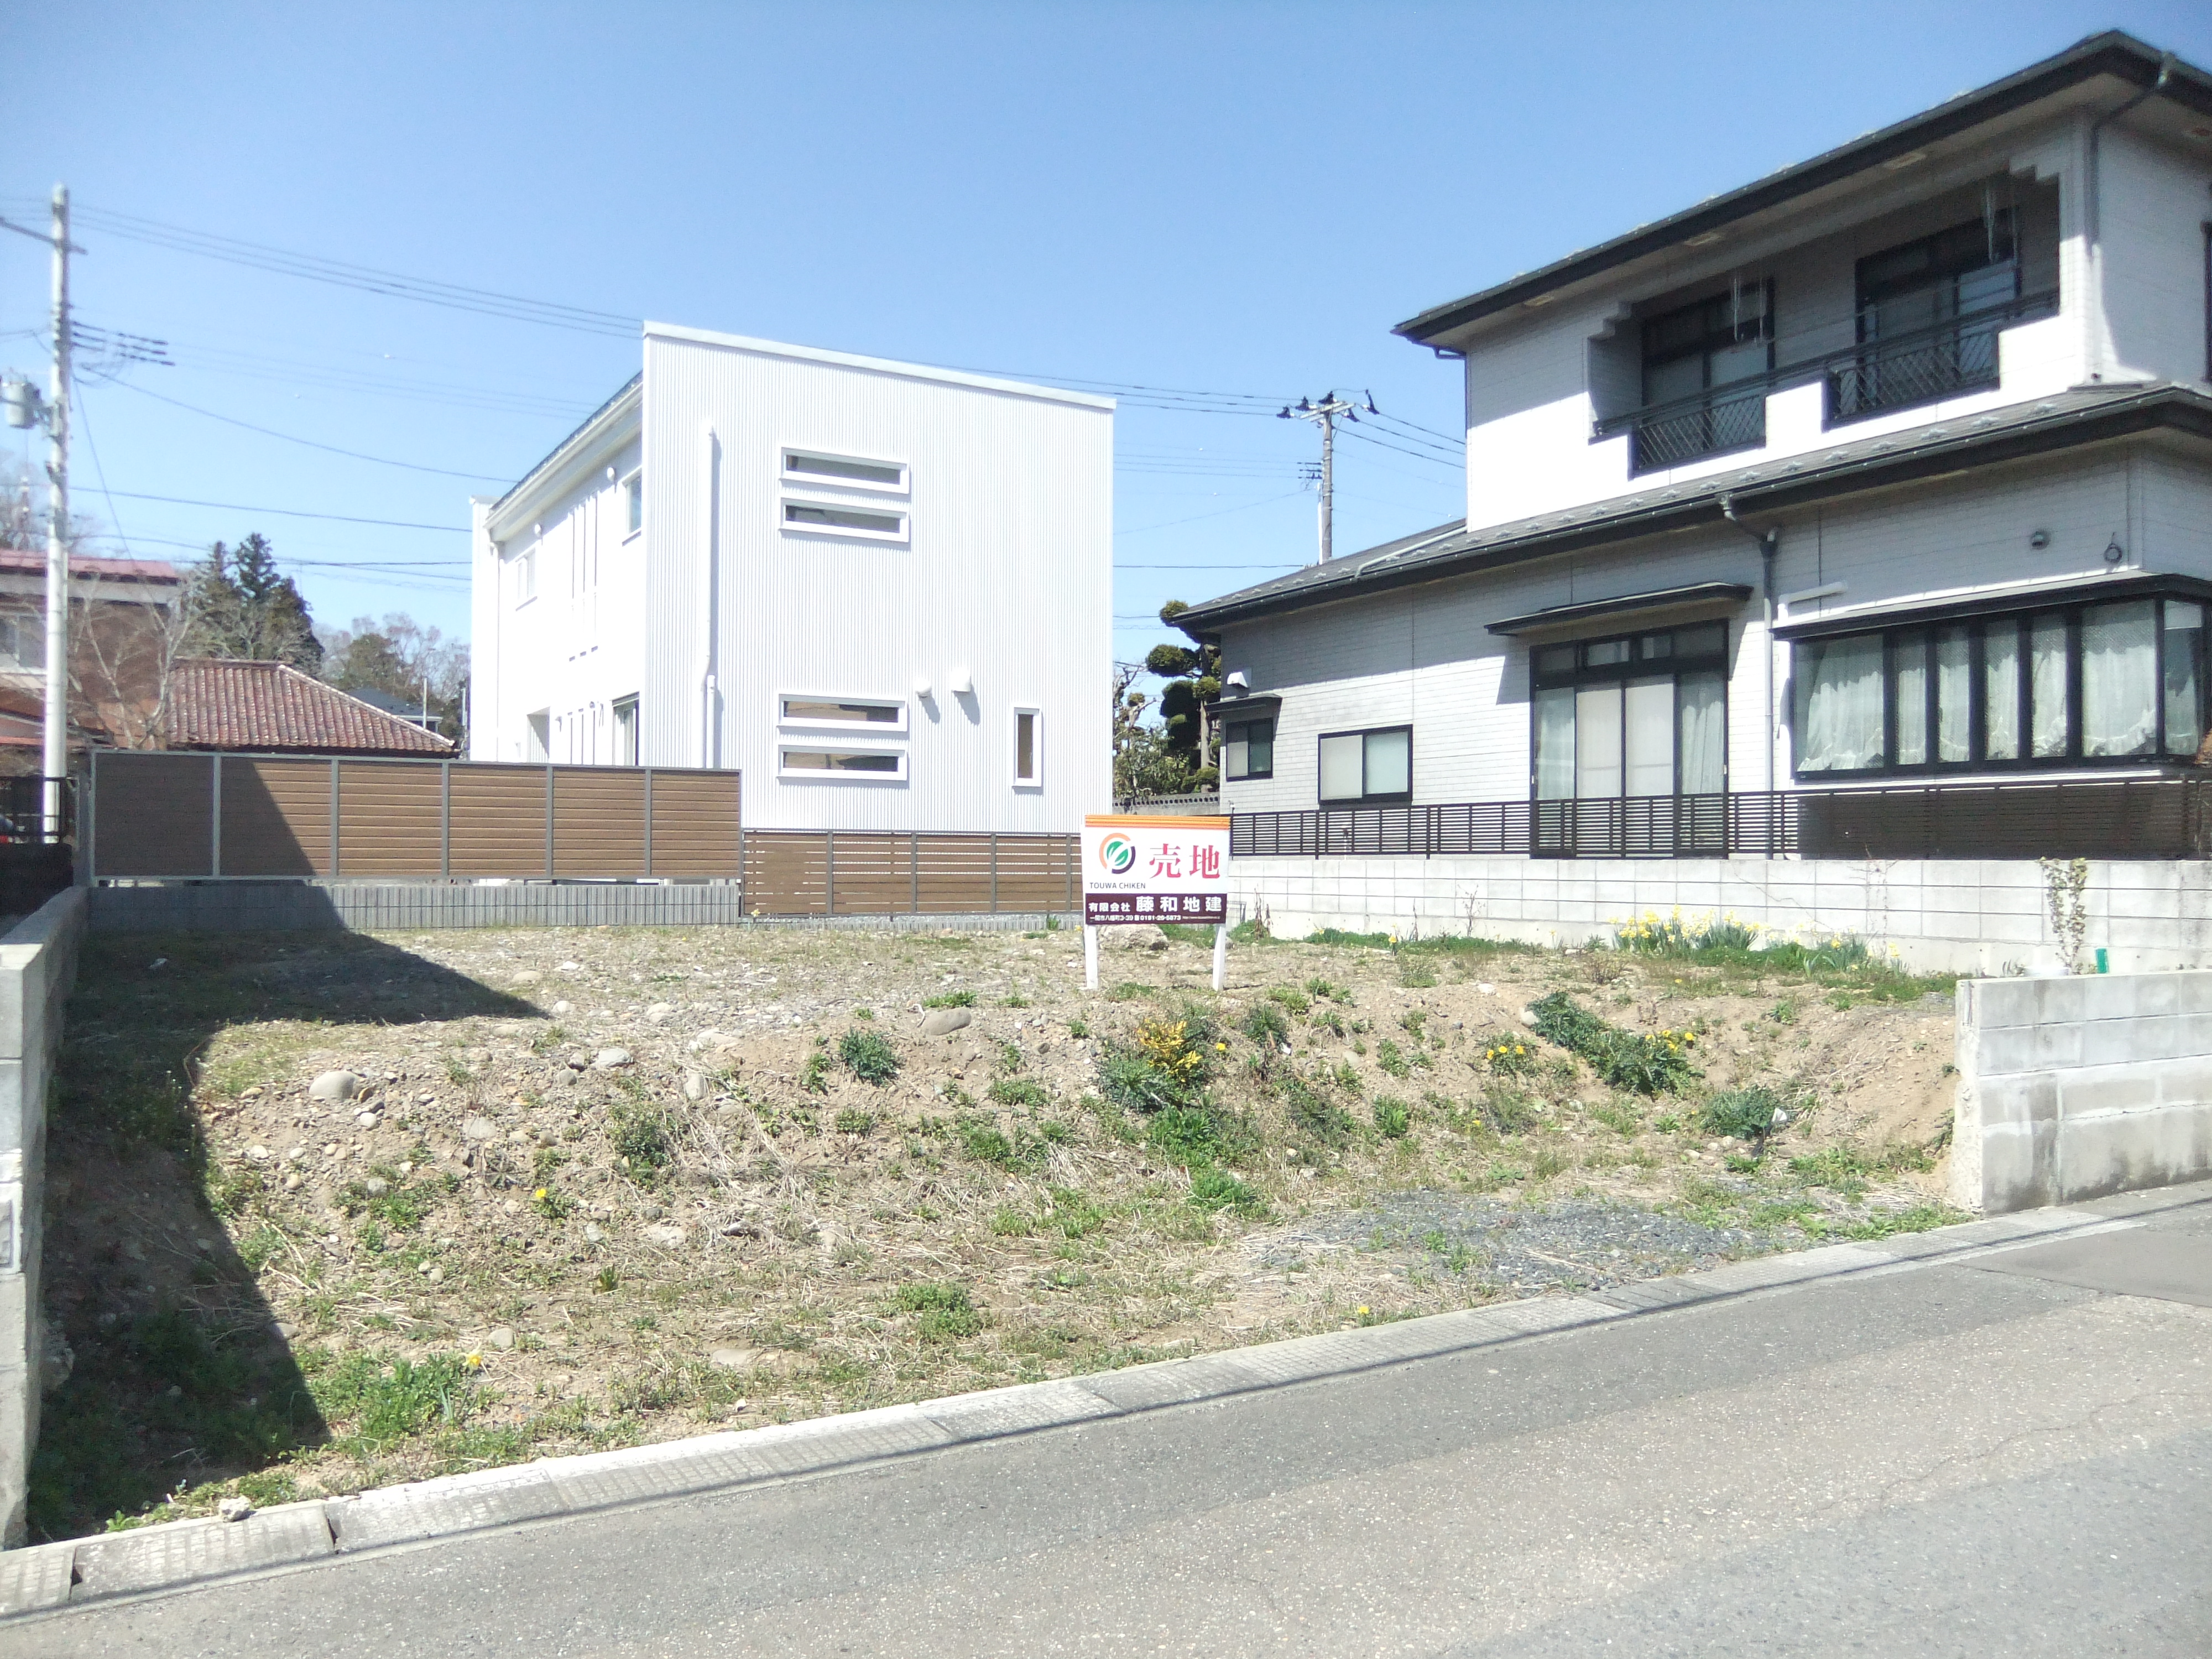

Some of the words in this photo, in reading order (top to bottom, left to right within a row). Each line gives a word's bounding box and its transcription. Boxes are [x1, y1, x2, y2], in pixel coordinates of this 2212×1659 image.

[1149, 843, 1220, 879] 売地
[1088, 902, 1130, 912] 有限会社
[1136, 896, 1222, 912] 藤和地建
